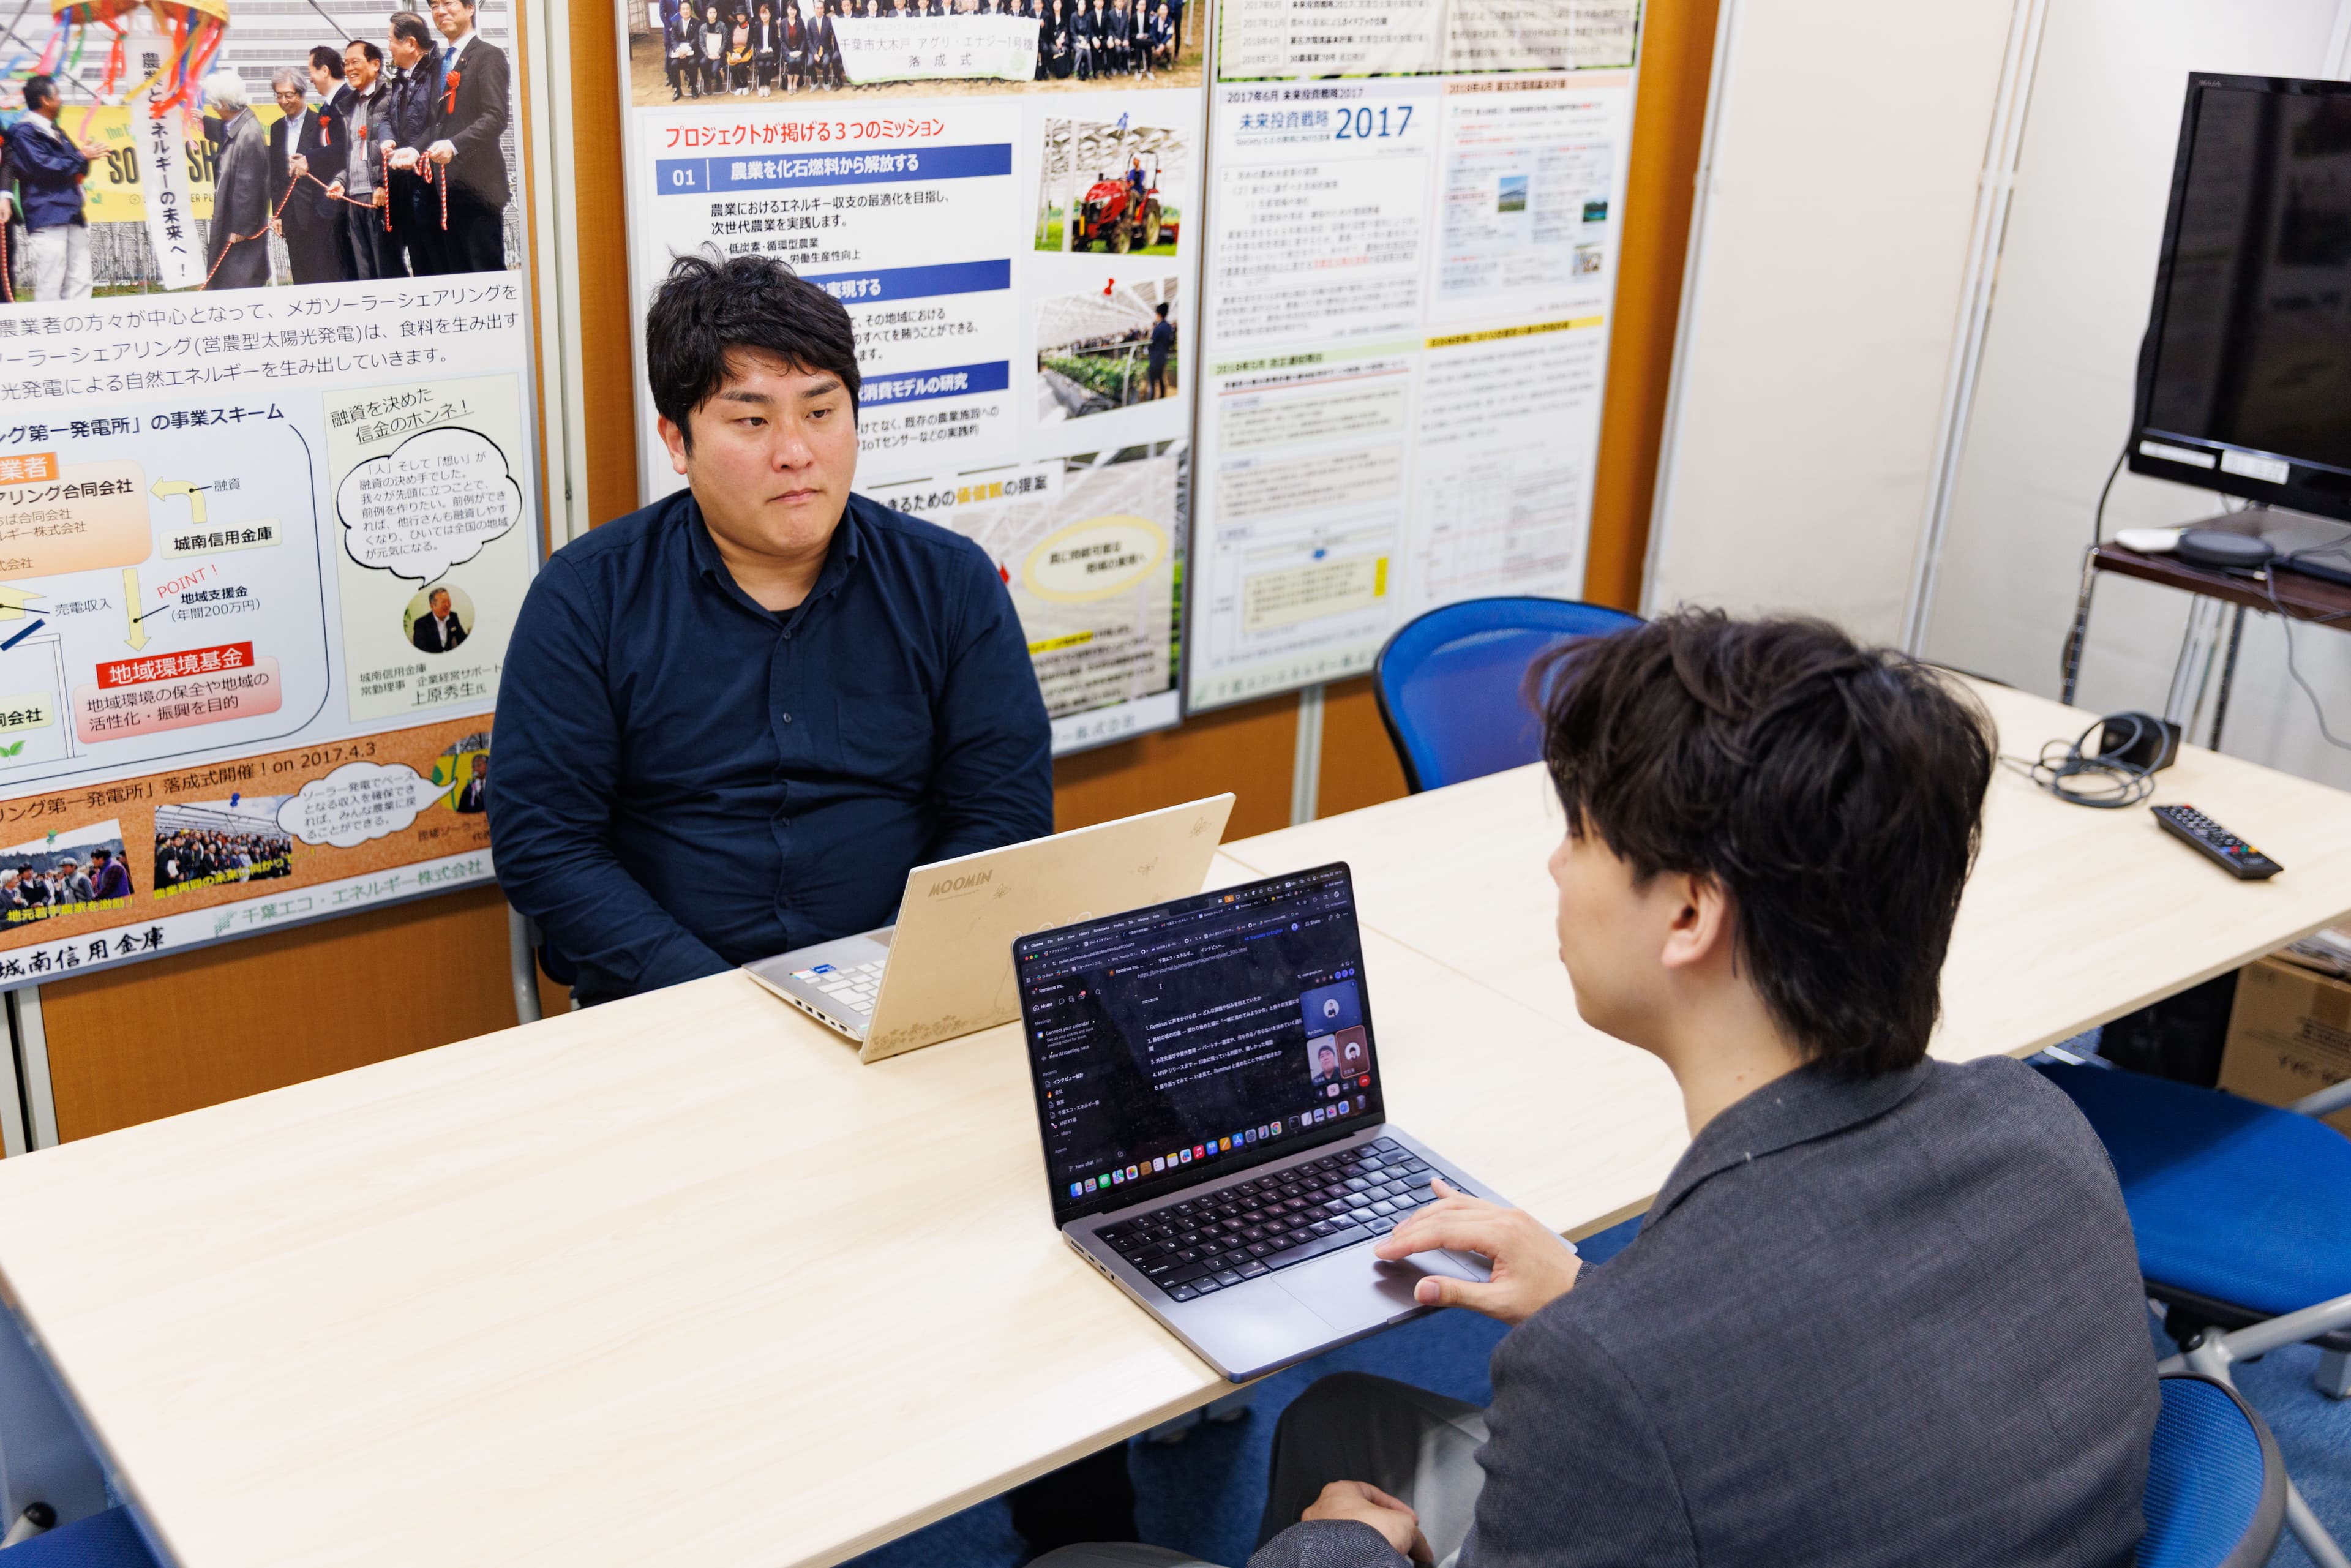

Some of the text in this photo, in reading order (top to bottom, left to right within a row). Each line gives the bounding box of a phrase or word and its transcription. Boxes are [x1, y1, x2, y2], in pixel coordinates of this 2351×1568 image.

[1335, 105, 1413, 140] 2017
[672, 153, 920, 187] 01 農業を化石燃料から解放する
[711, 213, 849, 236] 次世代農業を実践します。
[0, 284, 517, 338] 農業者の方々が中心となって、メガソーラーシェアリングを
[1, 347, 447, 401] 光発電による自然エネルギーを生み出していきます。
[330, 388, 434, 428] 融資を決めた
[356, 399, 468, 443] 信金のホンネ！
[0, 456, 48, 481] 業者
[359, 469, 467, 490] 融資の決め手でした。
[213, 478, 241, 492] 融資
[362, 491, 506, 519] 前例を作りたい。前例ができ
[364, 504, 508, 533] れば、他行さんも融資しやす
[174, 526, 274, 552] 城南信用金庫
[365, 517, 509, 545] くなり、ひいては全国の地域
[366, 541, 439, 561] が元気になる。
[55, 598, 113, 616] 売電収入
[181, 585, 248, 606] 地域支援金
[171, 597, 260, 623] (年間200万円)
[109, 647, 244, 685] 地域環境基金
[86, 672, 269, 713] 地域環境の保全や地域の
[361, 680, 405, 697] 常勤理事
[89, 695, 239, 732] 活性化・振興を目的
[301, 741, 377, 771] 2017.4.3
[302, 770, 415, 802] ソーラー発電でベース
[305, 785, 415, 815] となる収入を確保でき
[307, 819, 390, 840] ることができる。
[241, 858, 485, 923] 千葉エコ・エネルギー株式会社
[928, 869, 992, 897] MOOMIN
[0, 926, 165, 978] 城南信用金庫
[1150, 1021, 1168, 1030] Reminus
[1053, 1073, 1084, 1084] インタビュー設計
